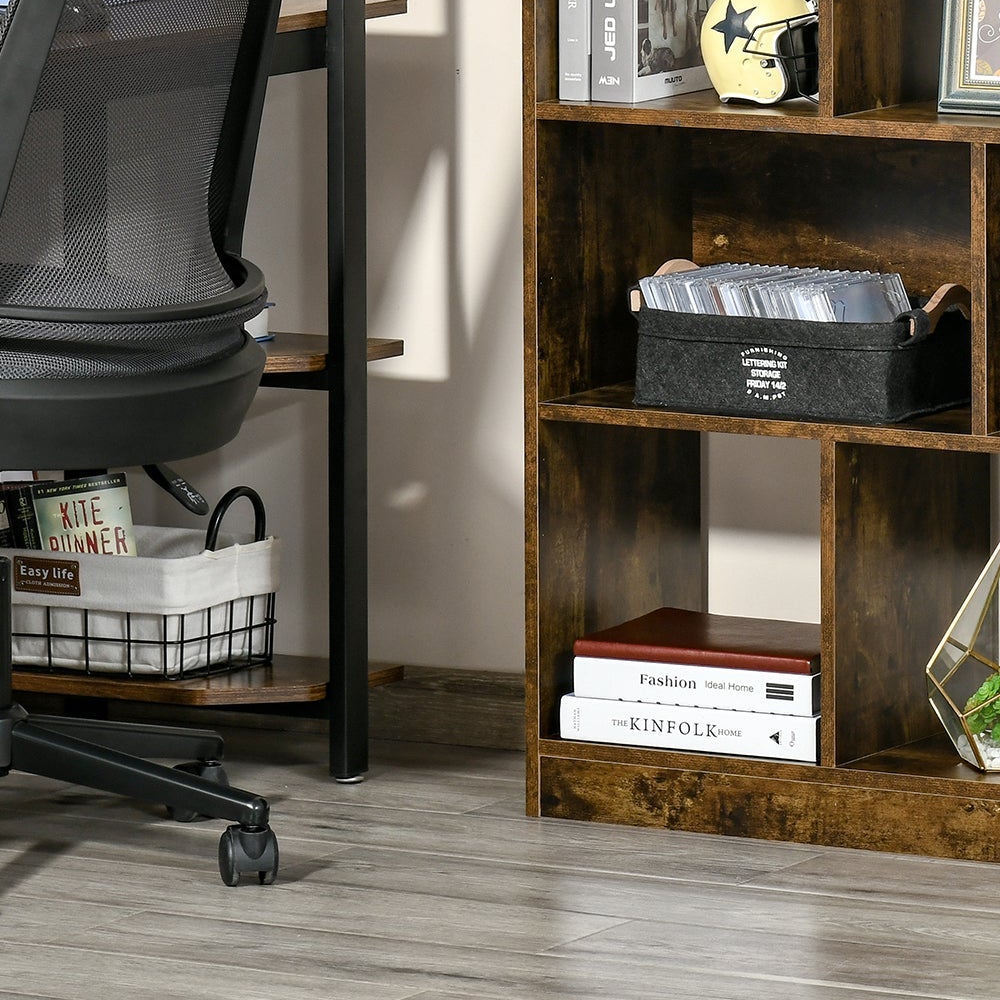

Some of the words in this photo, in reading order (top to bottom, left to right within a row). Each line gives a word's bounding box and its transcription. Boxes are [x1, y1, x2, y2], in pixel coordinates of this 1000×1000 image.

[604, 17, 616, 61] JED
[741, 347, 788, 360] FURNISHING
[742, 358, 776, 368] LETTERING
[777, 361, 787, 369] KIT
[751, 369, 781, 378] STORAGE
[747, 379, 770, 389] FRIDAY
[88, 479, 120, 487] BESTSELLER
[59, 496, 104, 530] KITE
[21, 565, 48, 579] Easy
[53, 567, 74, 580] life
[640, 674, 697, 689] Fashion
[705, 680, 726, 690] Ideal
[728, 682, 754, 692] Home
[612, 719, 629, 727] THE
[630, 717, 718, 738] KINFOLK
[717, 728, 742, 737] HOME
